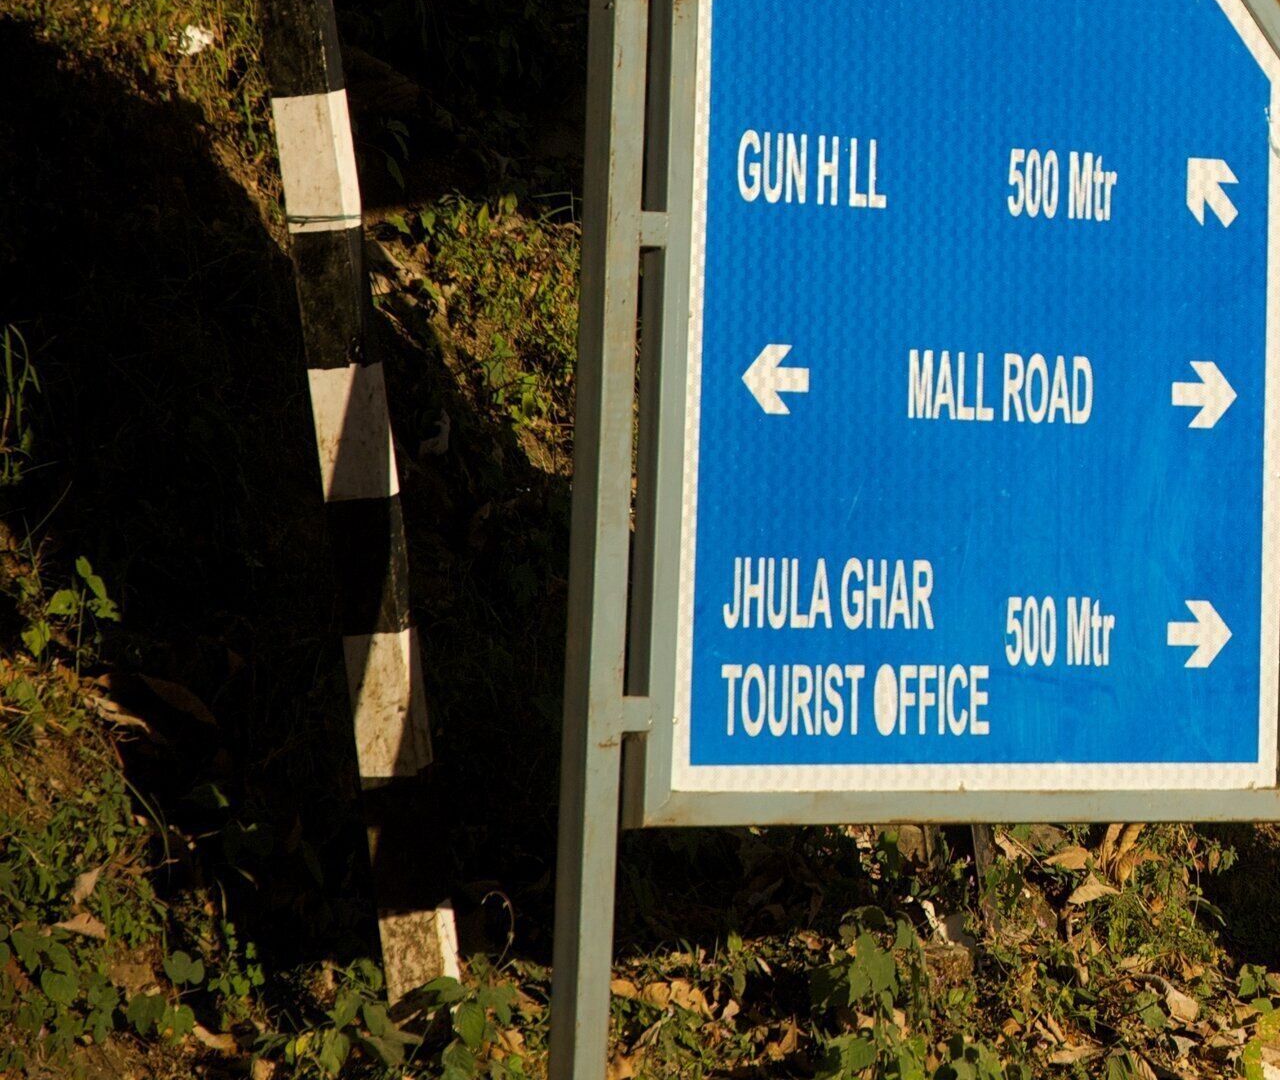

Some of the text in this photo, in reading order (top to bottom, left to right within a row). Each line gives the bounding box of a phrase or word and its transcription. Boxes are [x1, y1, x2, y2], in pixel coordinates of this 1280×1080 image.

[738, 130, 887, 208] GUN HLL
[1008, 148, 1118, 221] 500 Mtr
[908, 349, 1094, 424] MALL ROAD
[722, 557, 934, 630] JHULA GHAR
[1005, 596, 1115, 667] 500 Mtr
[721, 664, 990, 736] TOURIST OFFICE
